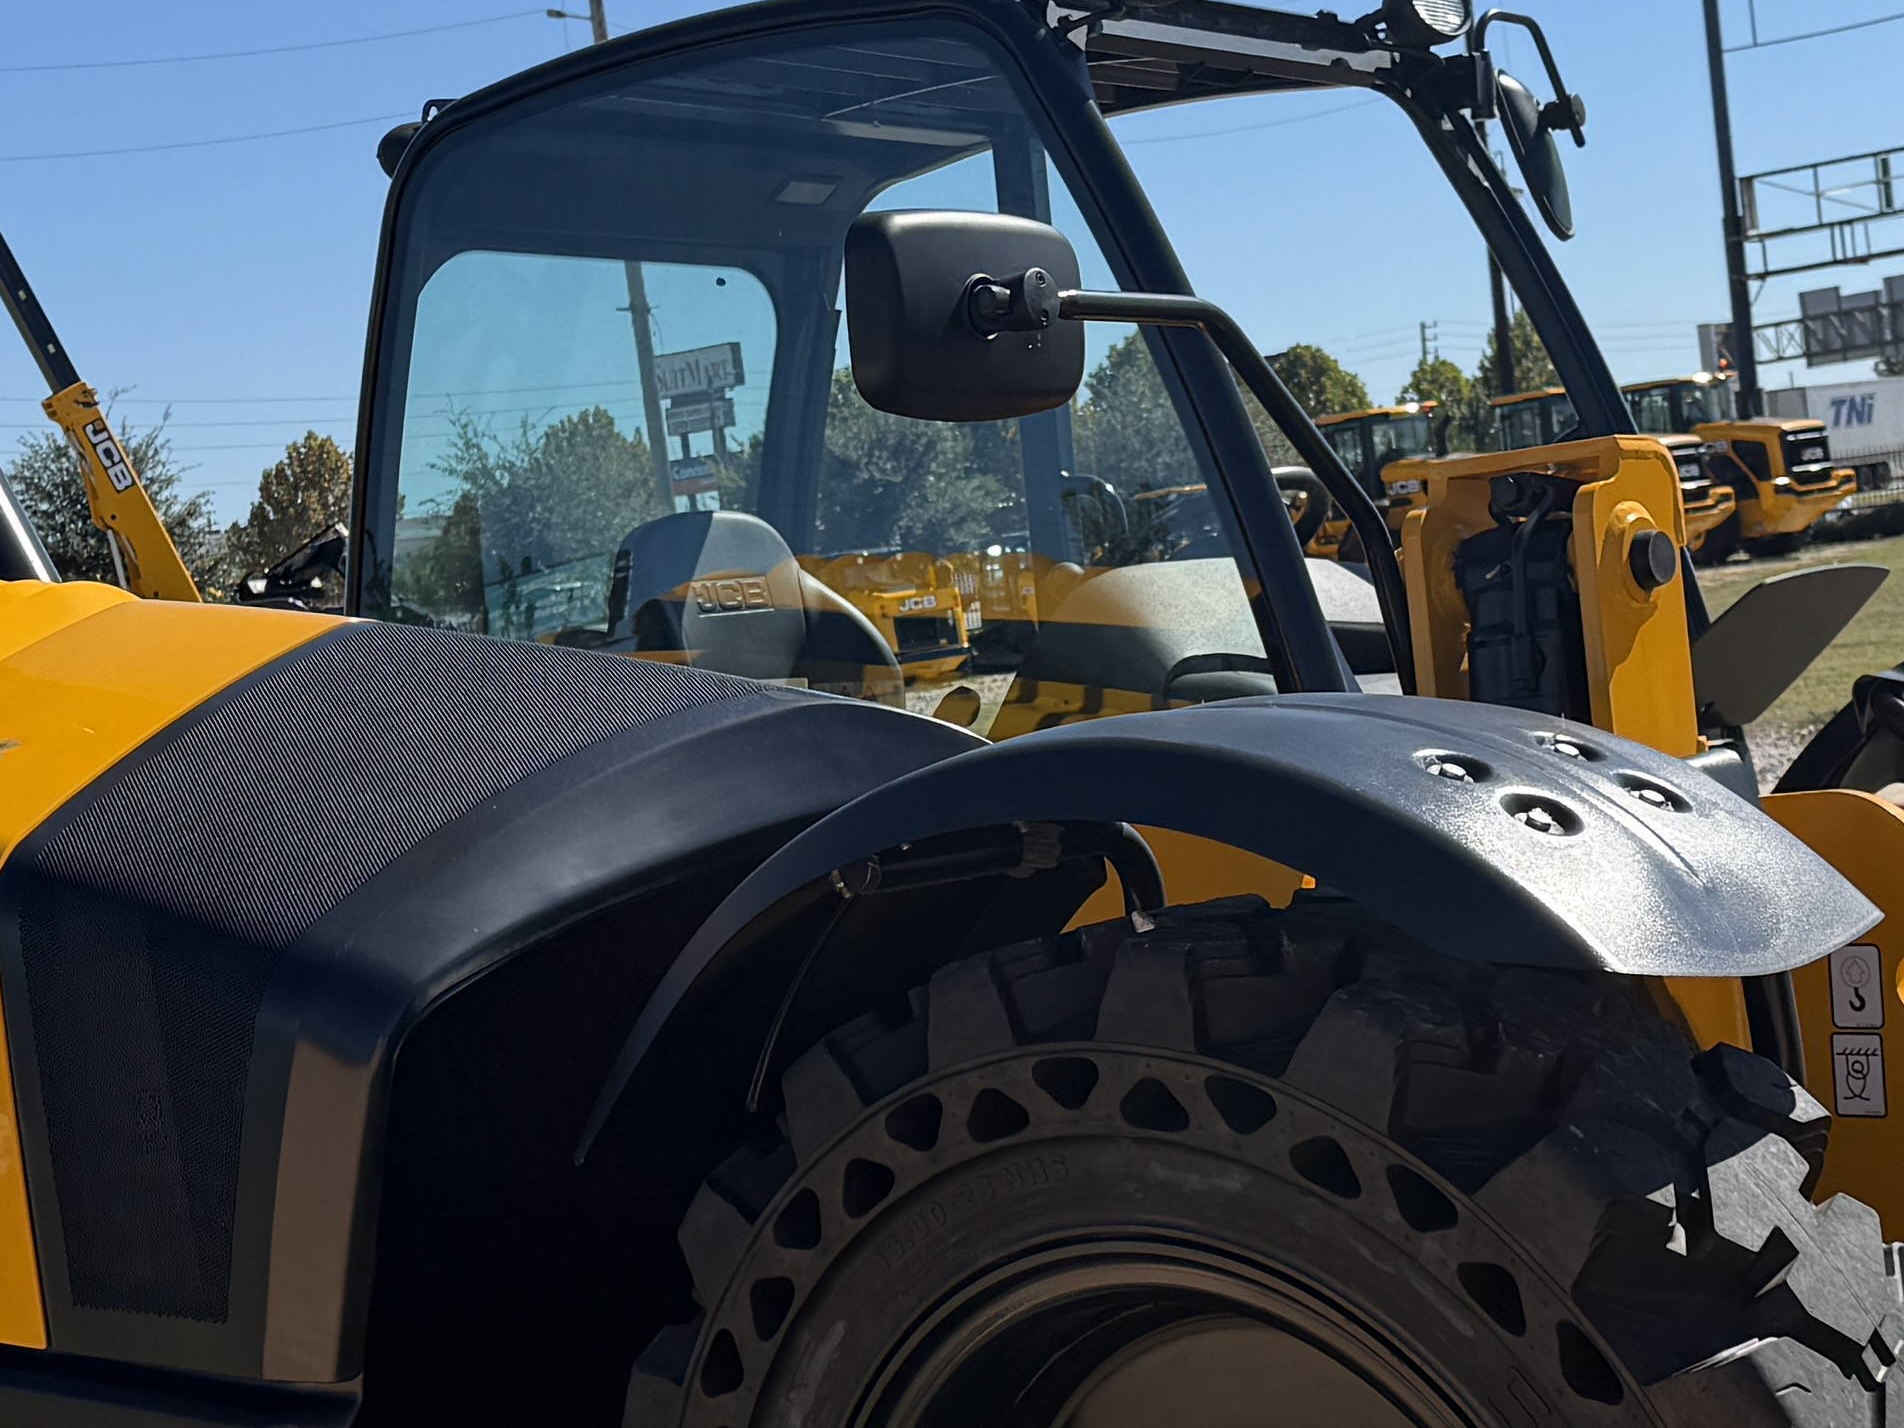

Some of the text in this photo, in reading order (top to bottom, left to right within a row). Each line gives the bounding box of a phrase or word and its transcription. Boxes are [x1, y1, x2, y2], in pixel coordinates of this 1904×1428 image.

[85, 423, 133, 491] JCB
[1387, 479, 1420, 495] JCB
[692, 578, 768, 614] JCB
[900, 595, 938, 612] JCB
